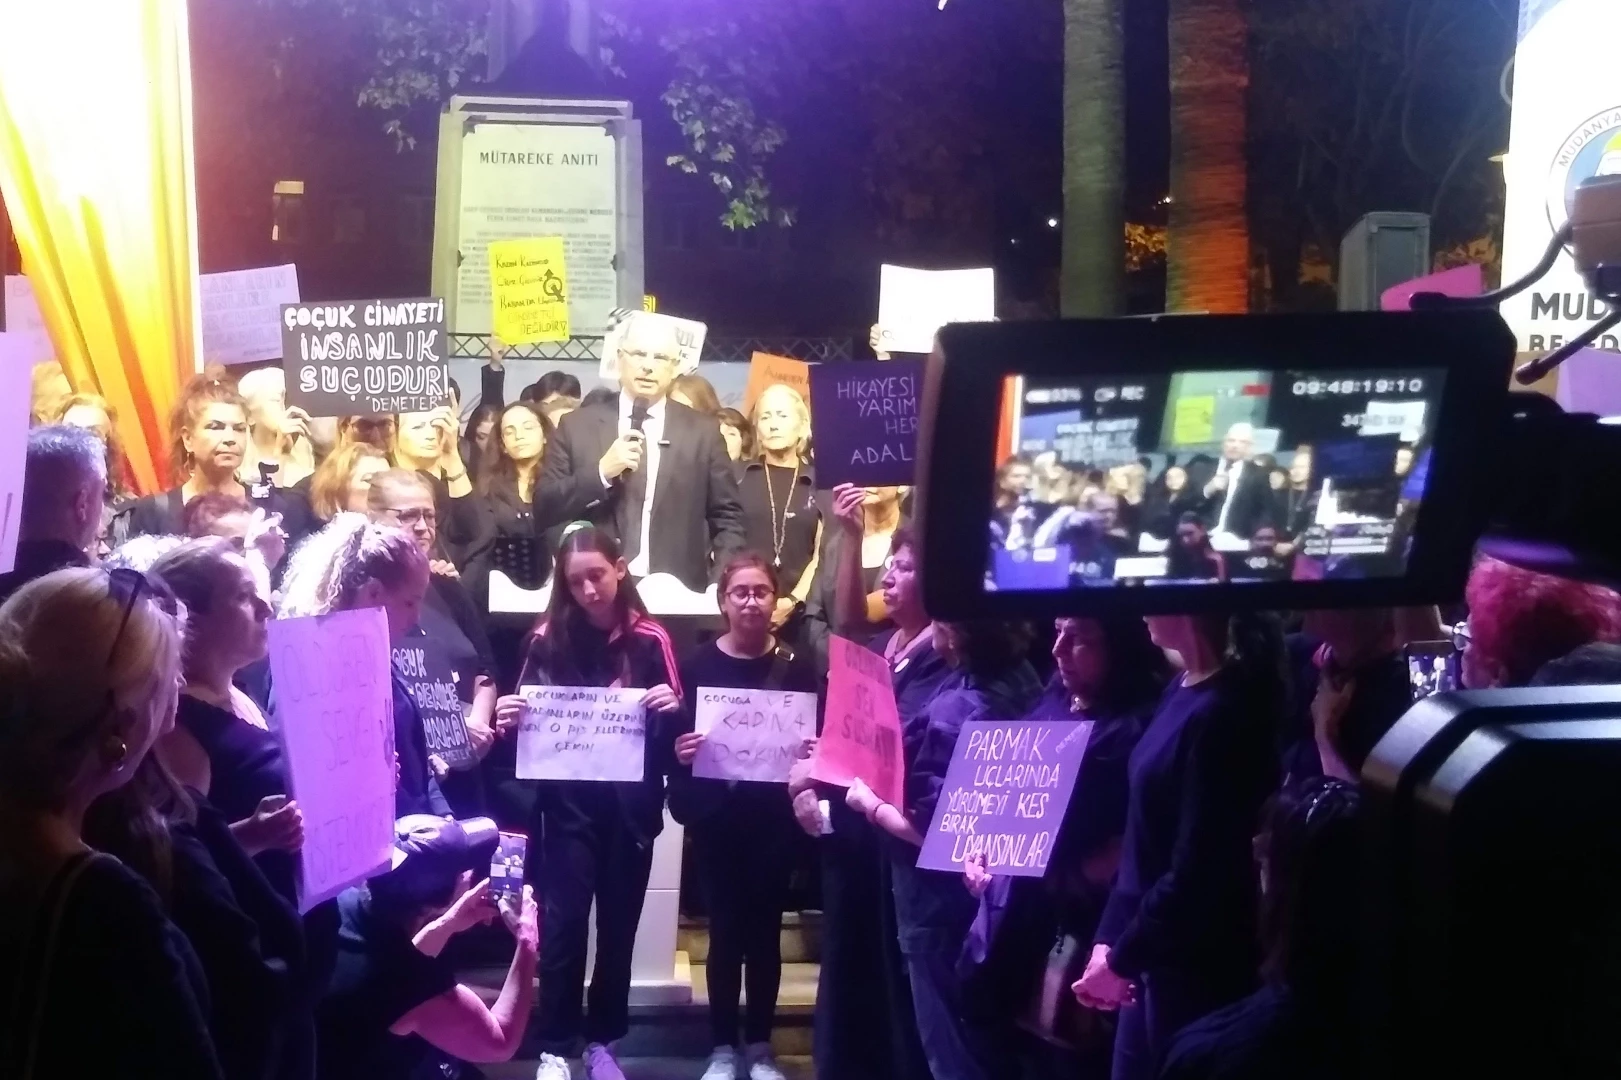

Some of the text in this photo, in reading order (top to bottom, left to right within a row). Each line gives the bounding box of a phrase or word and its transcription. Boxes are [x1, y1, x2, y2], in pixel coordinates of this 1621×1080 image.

[479, 150, 599, 167] MÜTAREKE ANITI
[284, 303, 357, 333] ÇOÇUK
[364, 298, 445, 331] CİNAYETİ
[300, 332, 439, 363] İNSANLIK
[300, 364, 450, 401] SUÇUDUR!
[857, 397, 916, 418] YARIM
[886, 416, 919, 435] HER
[851, 443, 914, 465] ADAL
[604, 693, 622, 704] VE
[767, 693, 795, 708] VE
[550, 722, 561, 733] O
[723, 710, 806, 733] KADINA
[964, 727, 1051, 761] PARMAK
[974, 763, 1061, 789] UÇLARINDA
[948, 787, 1050, 818] YÜRÜMEYİ KES
[940, 813, 979, 835] BIRAK
[951, 831, 1050, 868] UYANSINLAR
